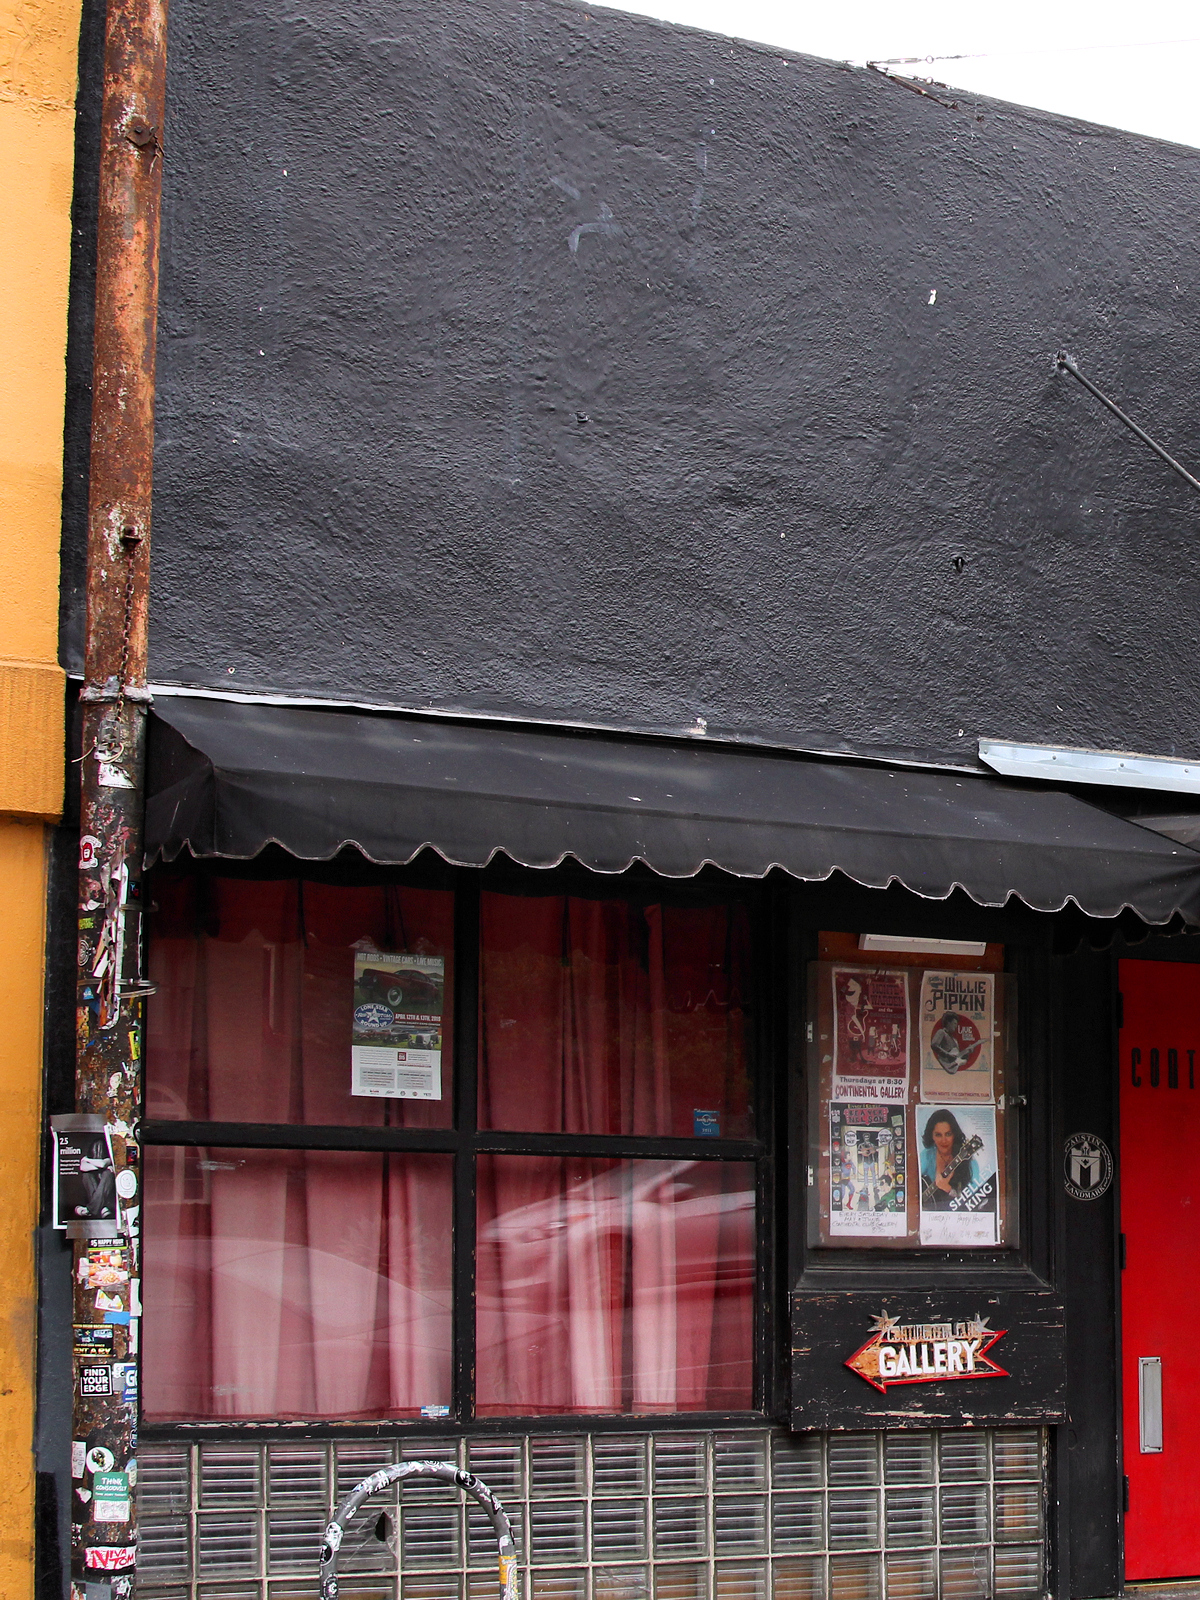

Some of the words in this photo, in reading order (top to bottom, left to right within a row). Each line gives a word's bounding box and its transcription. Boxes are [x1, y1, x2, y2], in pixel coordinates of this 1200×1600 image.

[382, 954, 401, 964] VINTAGE
[401, 956, 414, 964] CARS
[944, 977, 986, 994] WILLIE
[925, 989, 985, 1012] PIPKIN
[839, 1076, 877, 1086] Thursdays
[835, 1083, 878, 1098] CONTINENTAL
[880, 1085, 906, 1099] GALLERY
[1070, 1134, 1101, 1147] AUSTIN
[948, 1162, 995, 1212] SHELLEY
[1065, 1182, 1106, 1199] LANDMARK
[964, 1182, 993, 1212] KING
[879, 1339, 980, 1377] GALLERY
[83, 1368, 106, 1377] FIND
[83, 1376, 109, 1385] YOUR
[83, 1384, 109, 1393] EDGE
[101, 1477, 123, 1486] THINK
